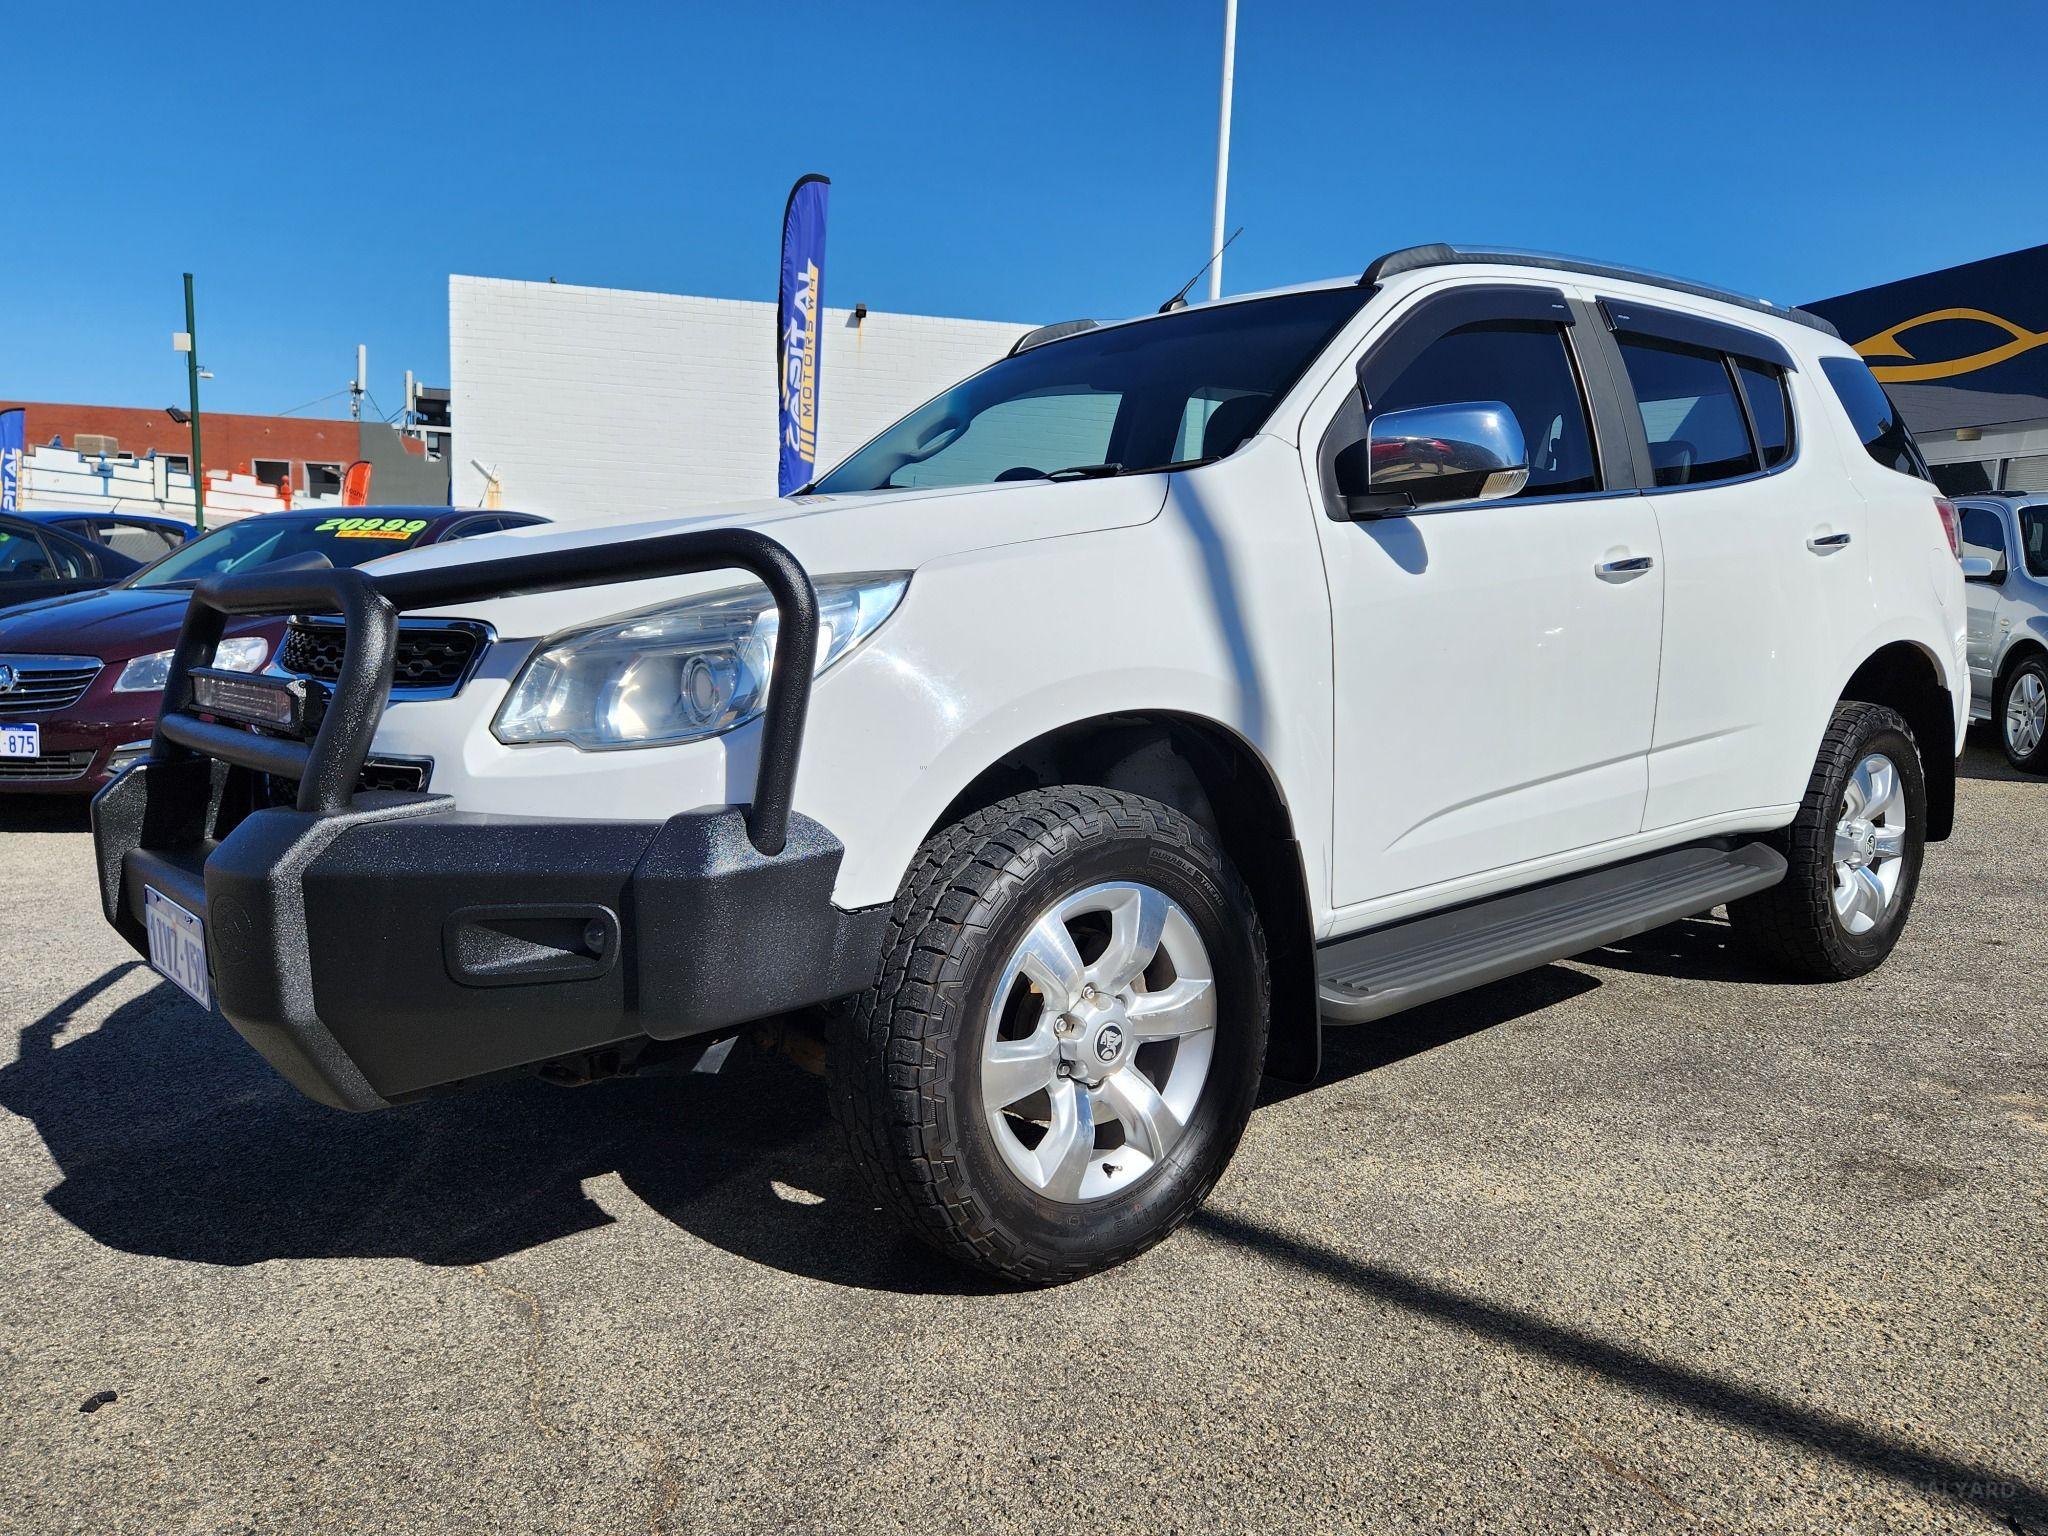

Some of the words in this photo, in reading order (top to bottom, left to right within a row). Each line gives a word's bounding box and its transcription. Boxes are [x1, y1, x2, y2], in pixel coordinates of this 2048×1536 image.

[802, 320, 814, 417] MOTORS
[314, 517, 427, 533] 20999
[8, 735, 35, 754] 875
